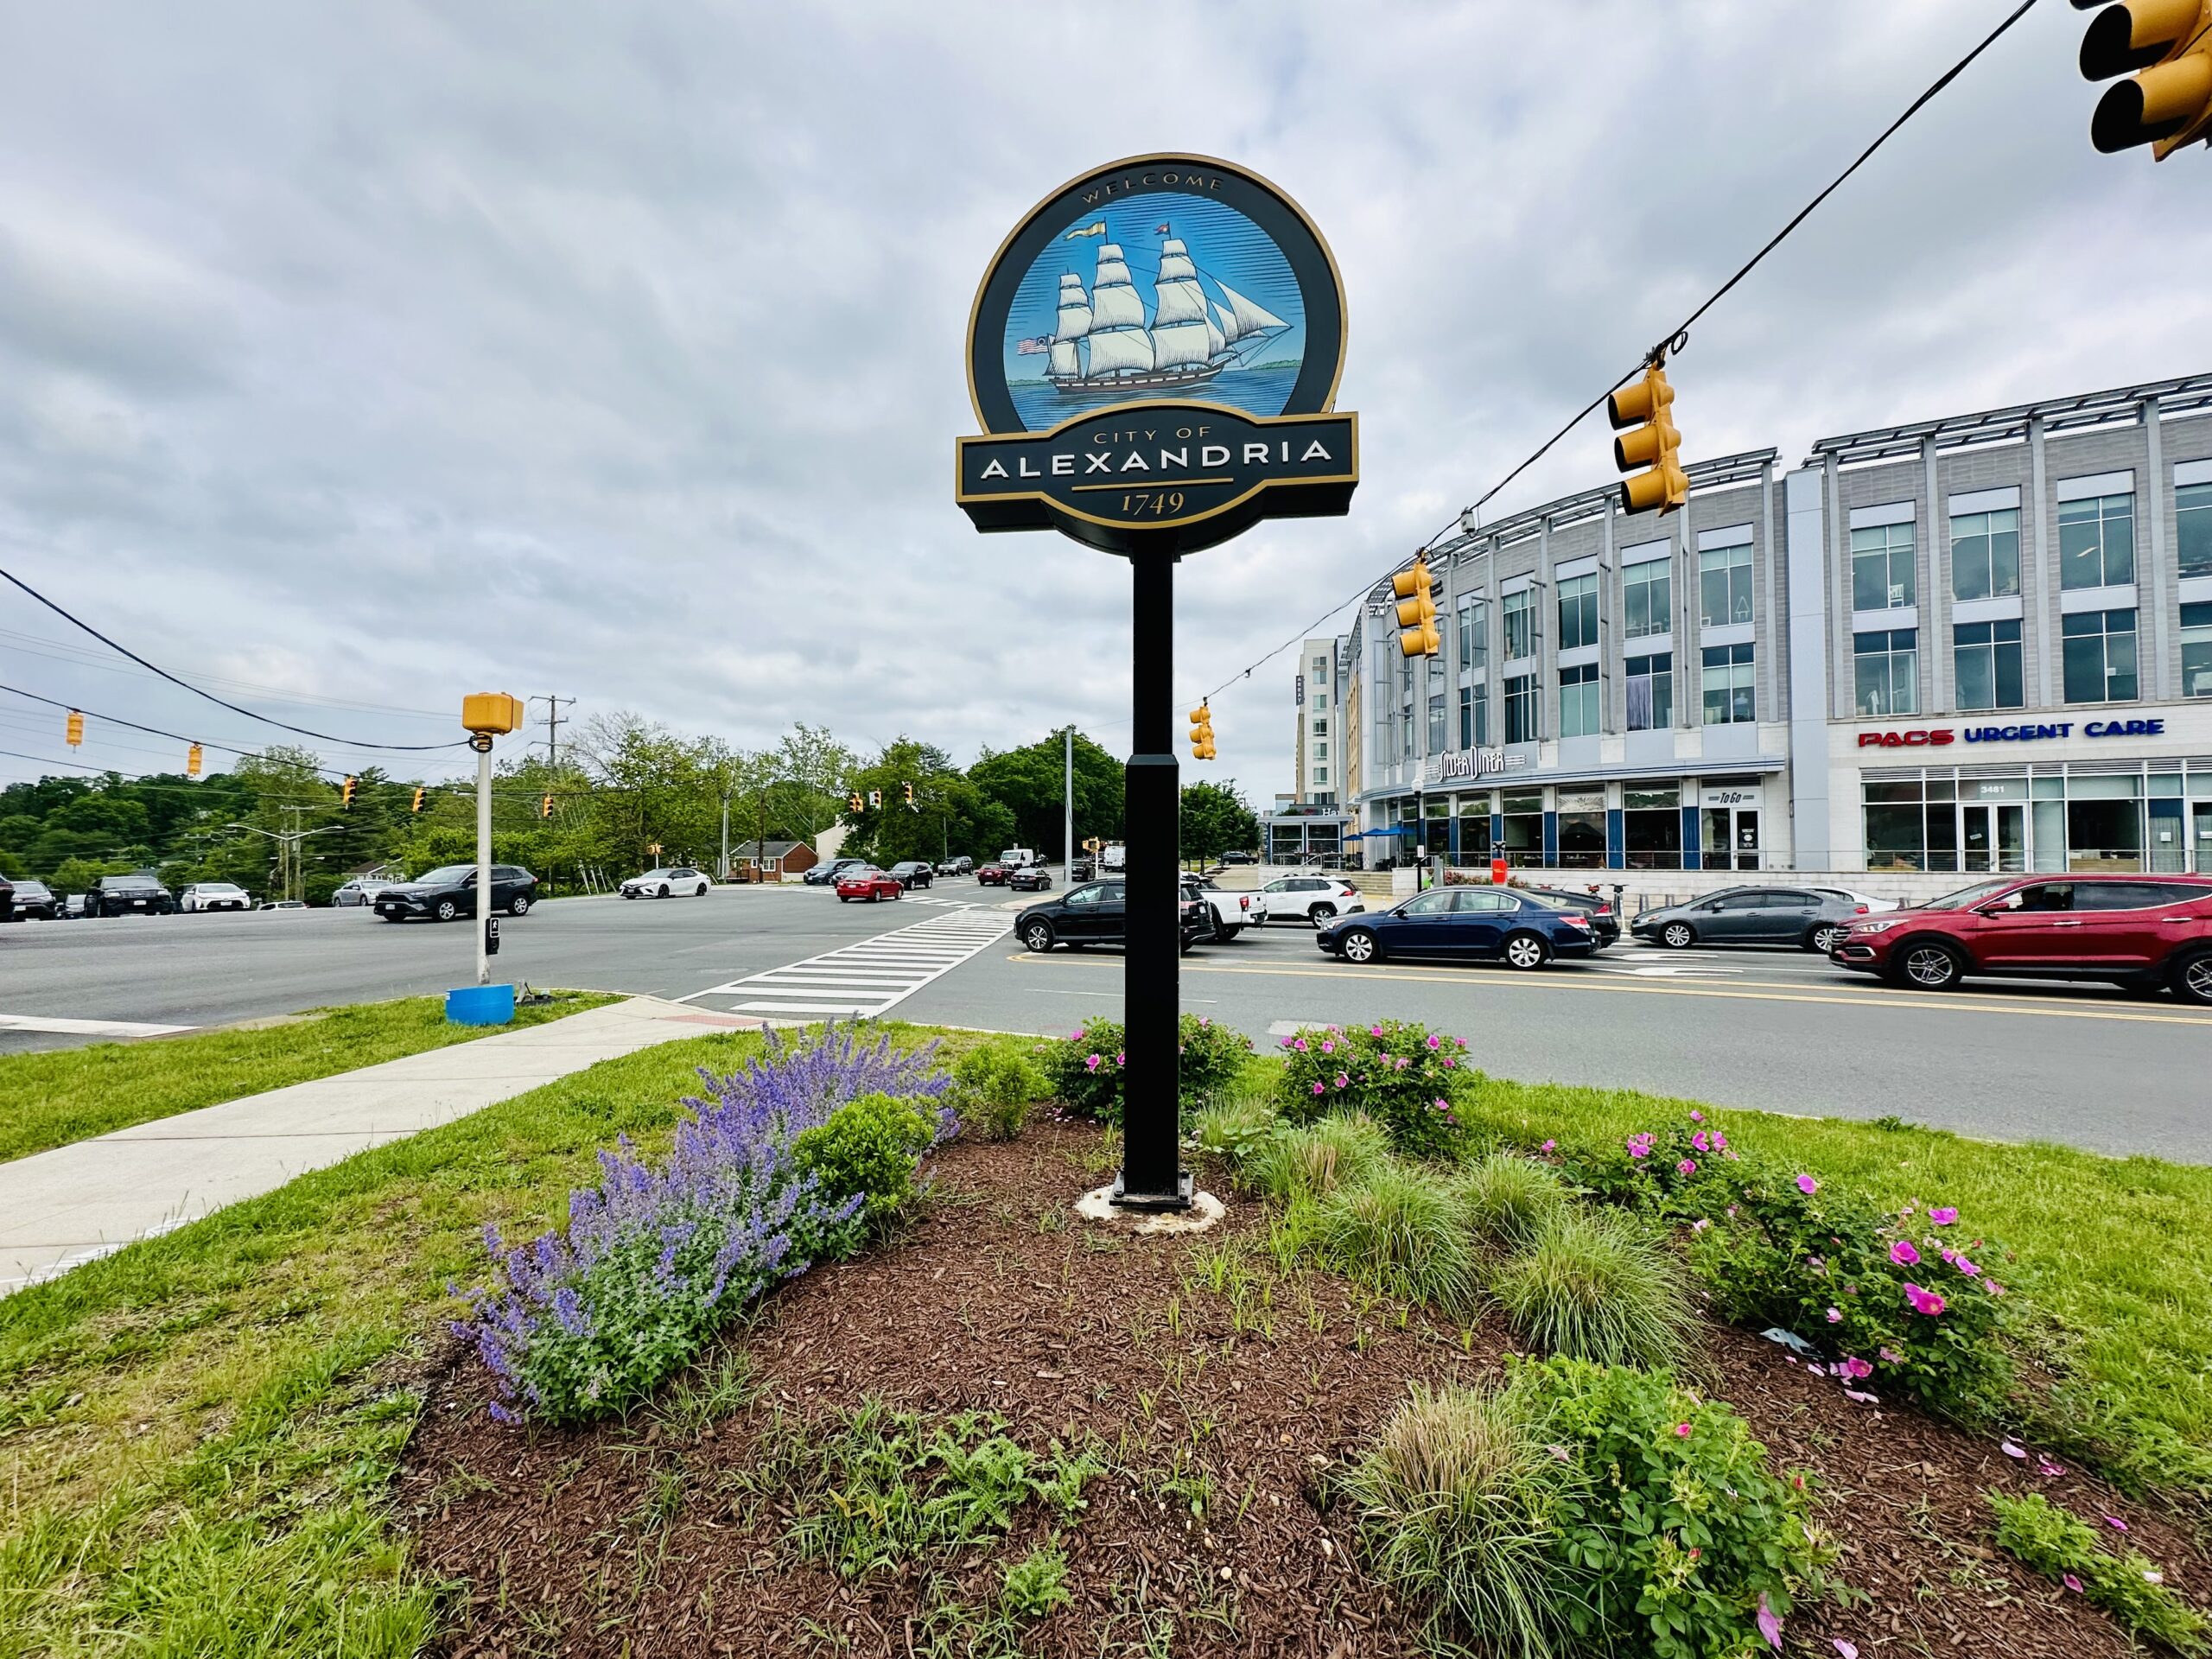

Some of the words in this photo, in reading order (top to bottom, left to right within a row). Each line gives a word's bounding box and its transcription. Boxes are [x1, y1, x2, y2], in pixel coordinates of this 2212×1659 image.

[1082, 172, 1224, 204] WELCOME
[1094, 430, 1157, 445] CITY
[1176, 426, 1211, 439] OF
[981, 439, 1332, 480] ALEXANDRIA
[1122, 491, 1185, 516] 1749
[1859, 729, 1955, 747] PACS
[1964, 723, 2074, 742] URGENT
[2084, 719, 2164, 737] CARE
